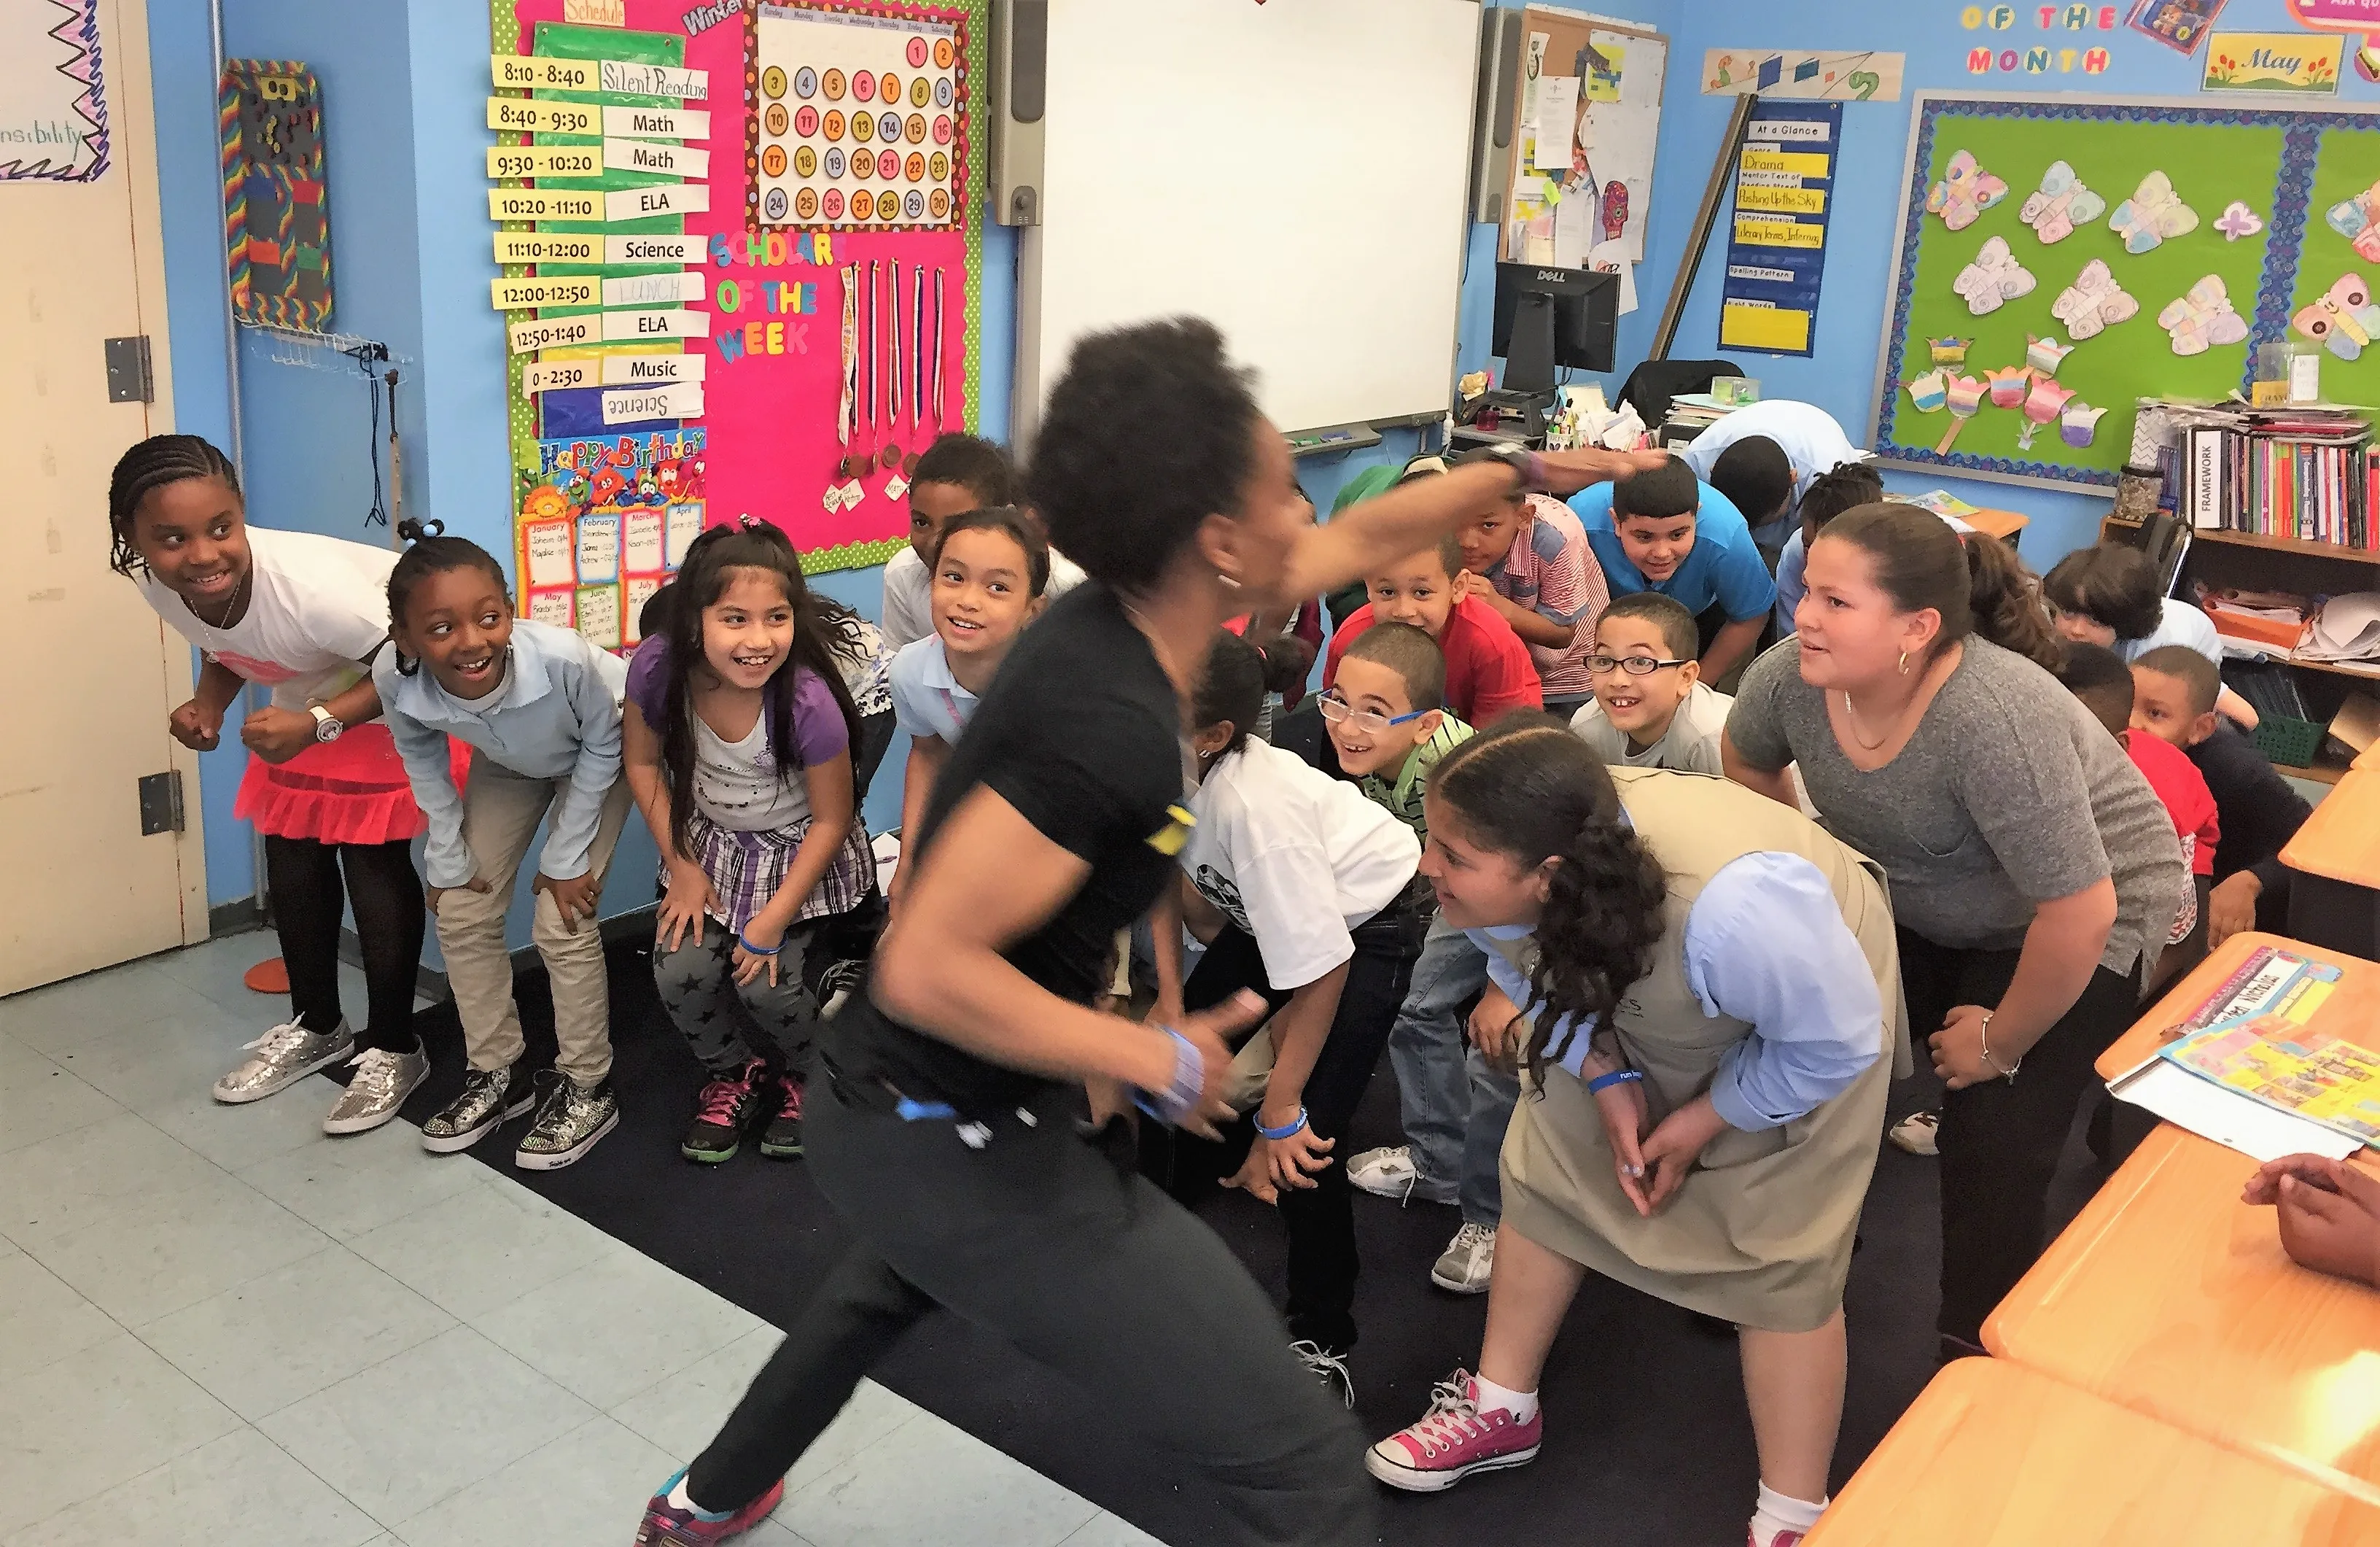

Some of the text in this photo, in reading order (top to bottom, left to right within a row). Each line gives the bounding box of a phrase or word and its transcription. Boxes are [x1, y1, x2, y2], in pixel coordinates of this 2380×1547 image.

[1961, 6, 2117, 30] OF THE
[914, 46, 946, 60] 1 2
[1968, 49, 2107, 72] MONTH
[2241, 48, 2302, 75] May
[505, 62, 533, 82] 8:10
[547, 65, 584, 87] 8:40
[603, 63, 707, 98] Silent Reading
[771, 76, 946, 98] 3 4 5 6 7 8 9
[500, 105, 537, 128] 8:40
[551, 112, 588, 131] 9:30
[633, 115, 674, 132] Math
[771, 113, 948, 136] 10 11 12 13 14 15 16
[1757, 125, 1767, 133] At
[1781, 125, 1818, 135] Glance
[497, 156, 534, 175] 9:30
[548, 156, 592, 171] 10:20
[633, 149, 674, 168] Math
[769, 155, 944, 174] 17 18 19 20 21 22 23
[1744, 155, 1784, 170] Drama
[502, 199, 545, 214] 10:20
[641, 193, 670, 212] ELA
[770, 197, 945, 212] 24 25 26 27 28 29 30
[1797, 192, 1816, 211] Sky
[626, 241, 684, 258] Science
[1537, 270, 1566, 283] DELL
[620, 276, 680, 301] LUNCH
[717, 279, 817, 314] OF THE
[638, 317, 668, 333] ELA
[716, 321, 809, 364] WEEK
[551, 368, 583, 387] 2:30
[631, 360, 677, 378] Music
[609, 395, 667, 416] Science
[540, 431, 705, 477] Happy Birthday
[2201, 445, 2212, 512] FRAMEWORK
[632, 513, 654, 522] March
[677, 507, 692, 516] April
[532, 523, 565, 533] January
[584, 519, 616, 527] February
[590, 590, 607, 598] June
[639, 581, 653, 589] July
[545, 593, 562, 602] May
